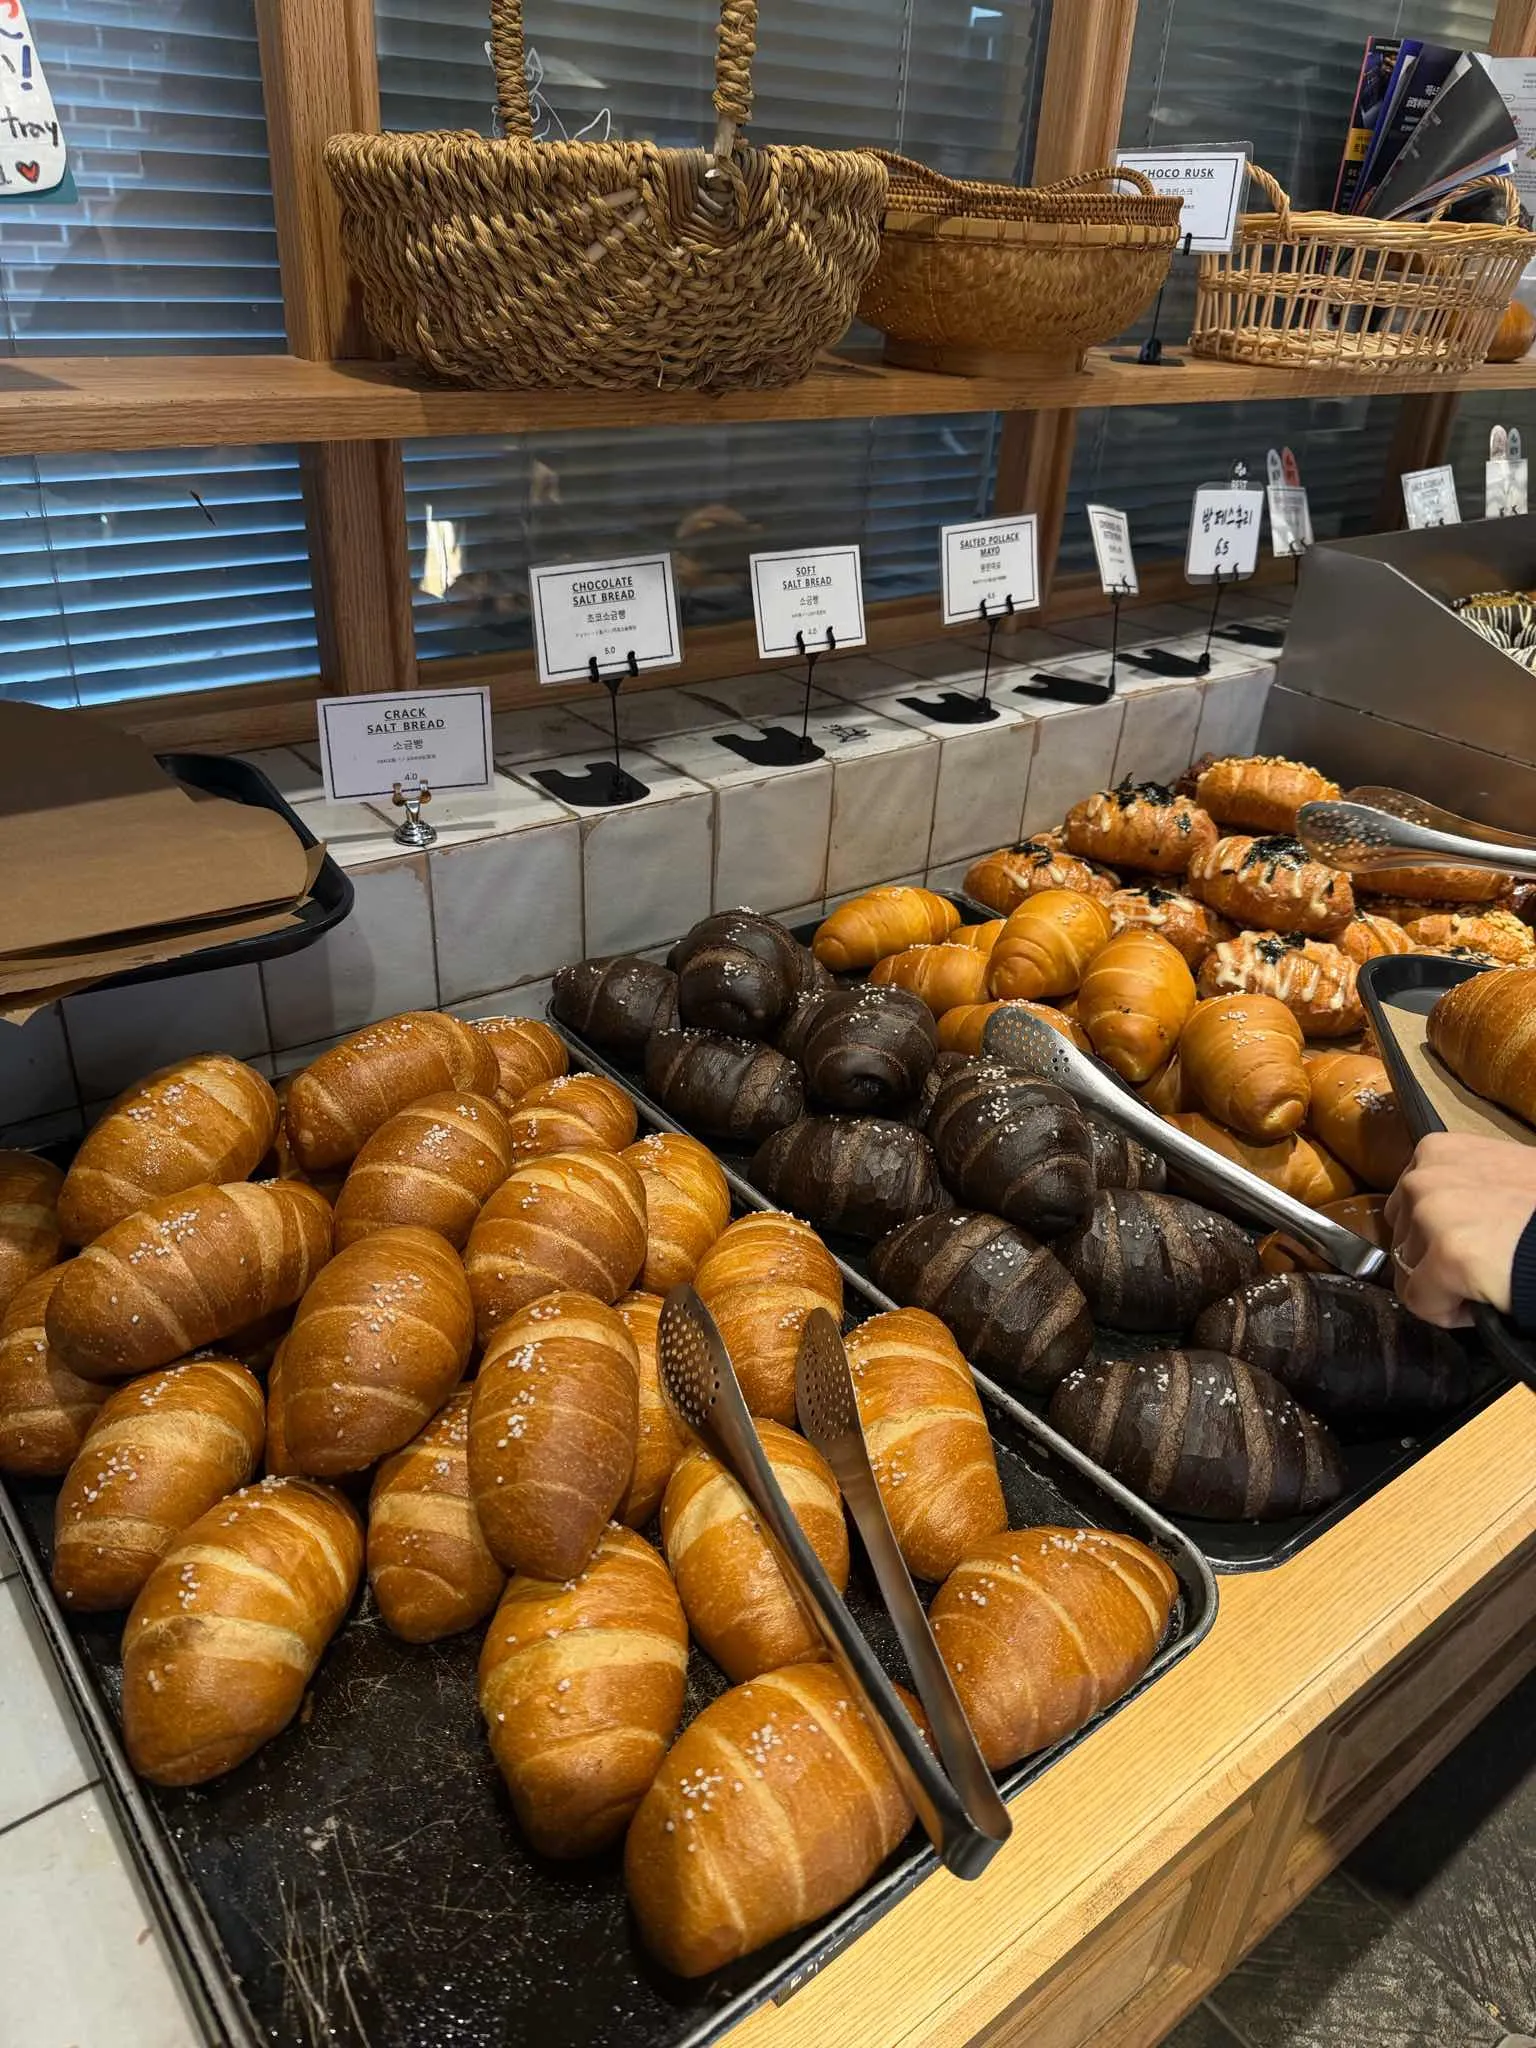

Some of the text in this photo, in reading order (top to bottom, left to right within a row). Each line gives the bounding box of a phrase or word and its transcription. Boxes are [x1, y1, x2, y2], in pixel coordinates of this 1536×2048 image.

[1, 106, 59, 148] tray
[1185, 167, 1215, 178] RUSK
[959, 532, 1019, 549] SALTED POLLACK
[980, 546, 1001, 557] MAYO
[795, 565, 817, 576] SOFT
[571, 576, 633, 592] CHOCOLATE
[782, 576, 833, 590] SALT BREAD
[572, 589, 635, 606] SALT BREAD
[384, 708, 426, 720] CRACK
[367, 719, 446, 734] SALT BREAD
